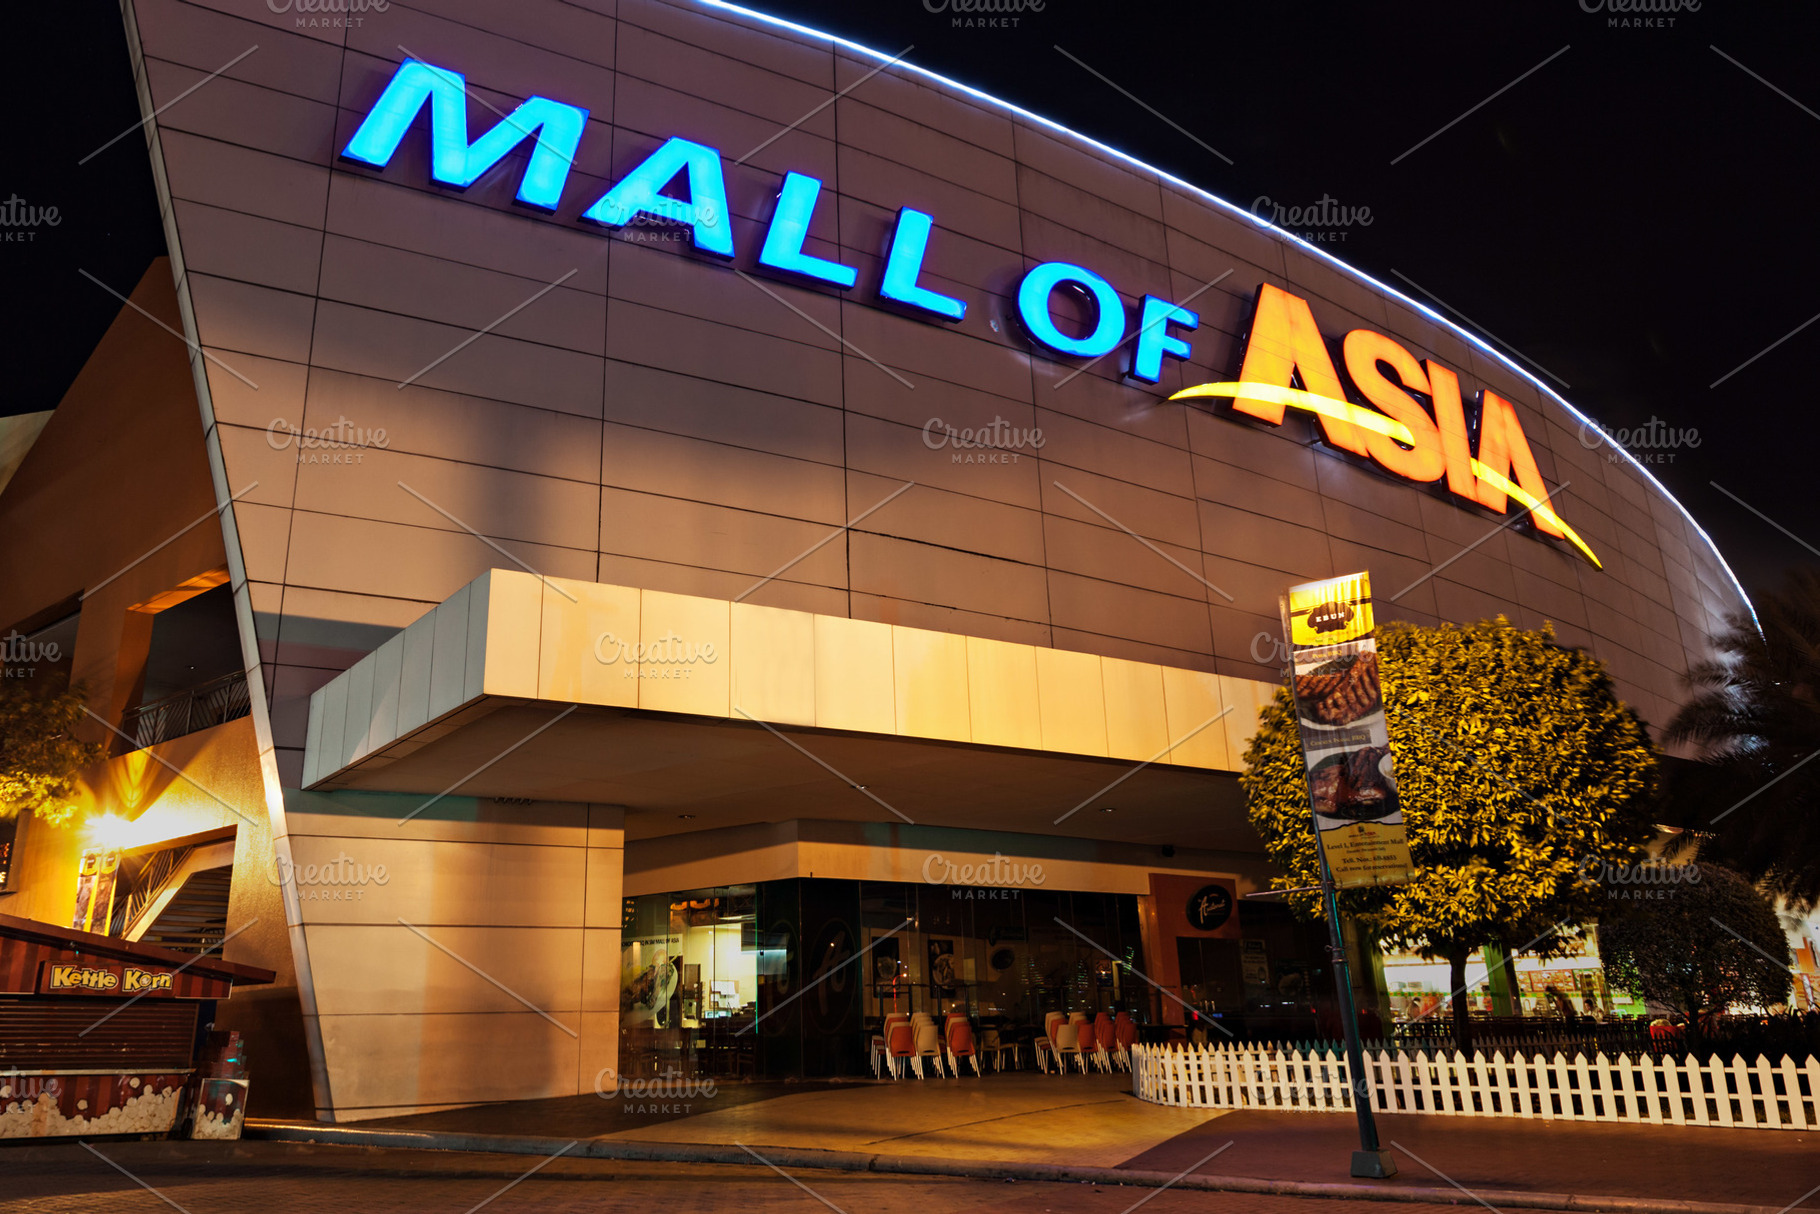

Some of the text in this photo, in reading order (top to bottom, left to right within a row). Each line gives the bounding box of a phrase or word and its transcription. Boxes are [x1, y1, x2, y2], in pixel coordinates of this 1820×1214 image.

[340, 58, 1566, 541] MALL OF ASIA
[1316, 612, 1345, 622] EBUN
[1327, 842, 1343, 850] Level
[50, 965, 173, 992] Kettle Korn
